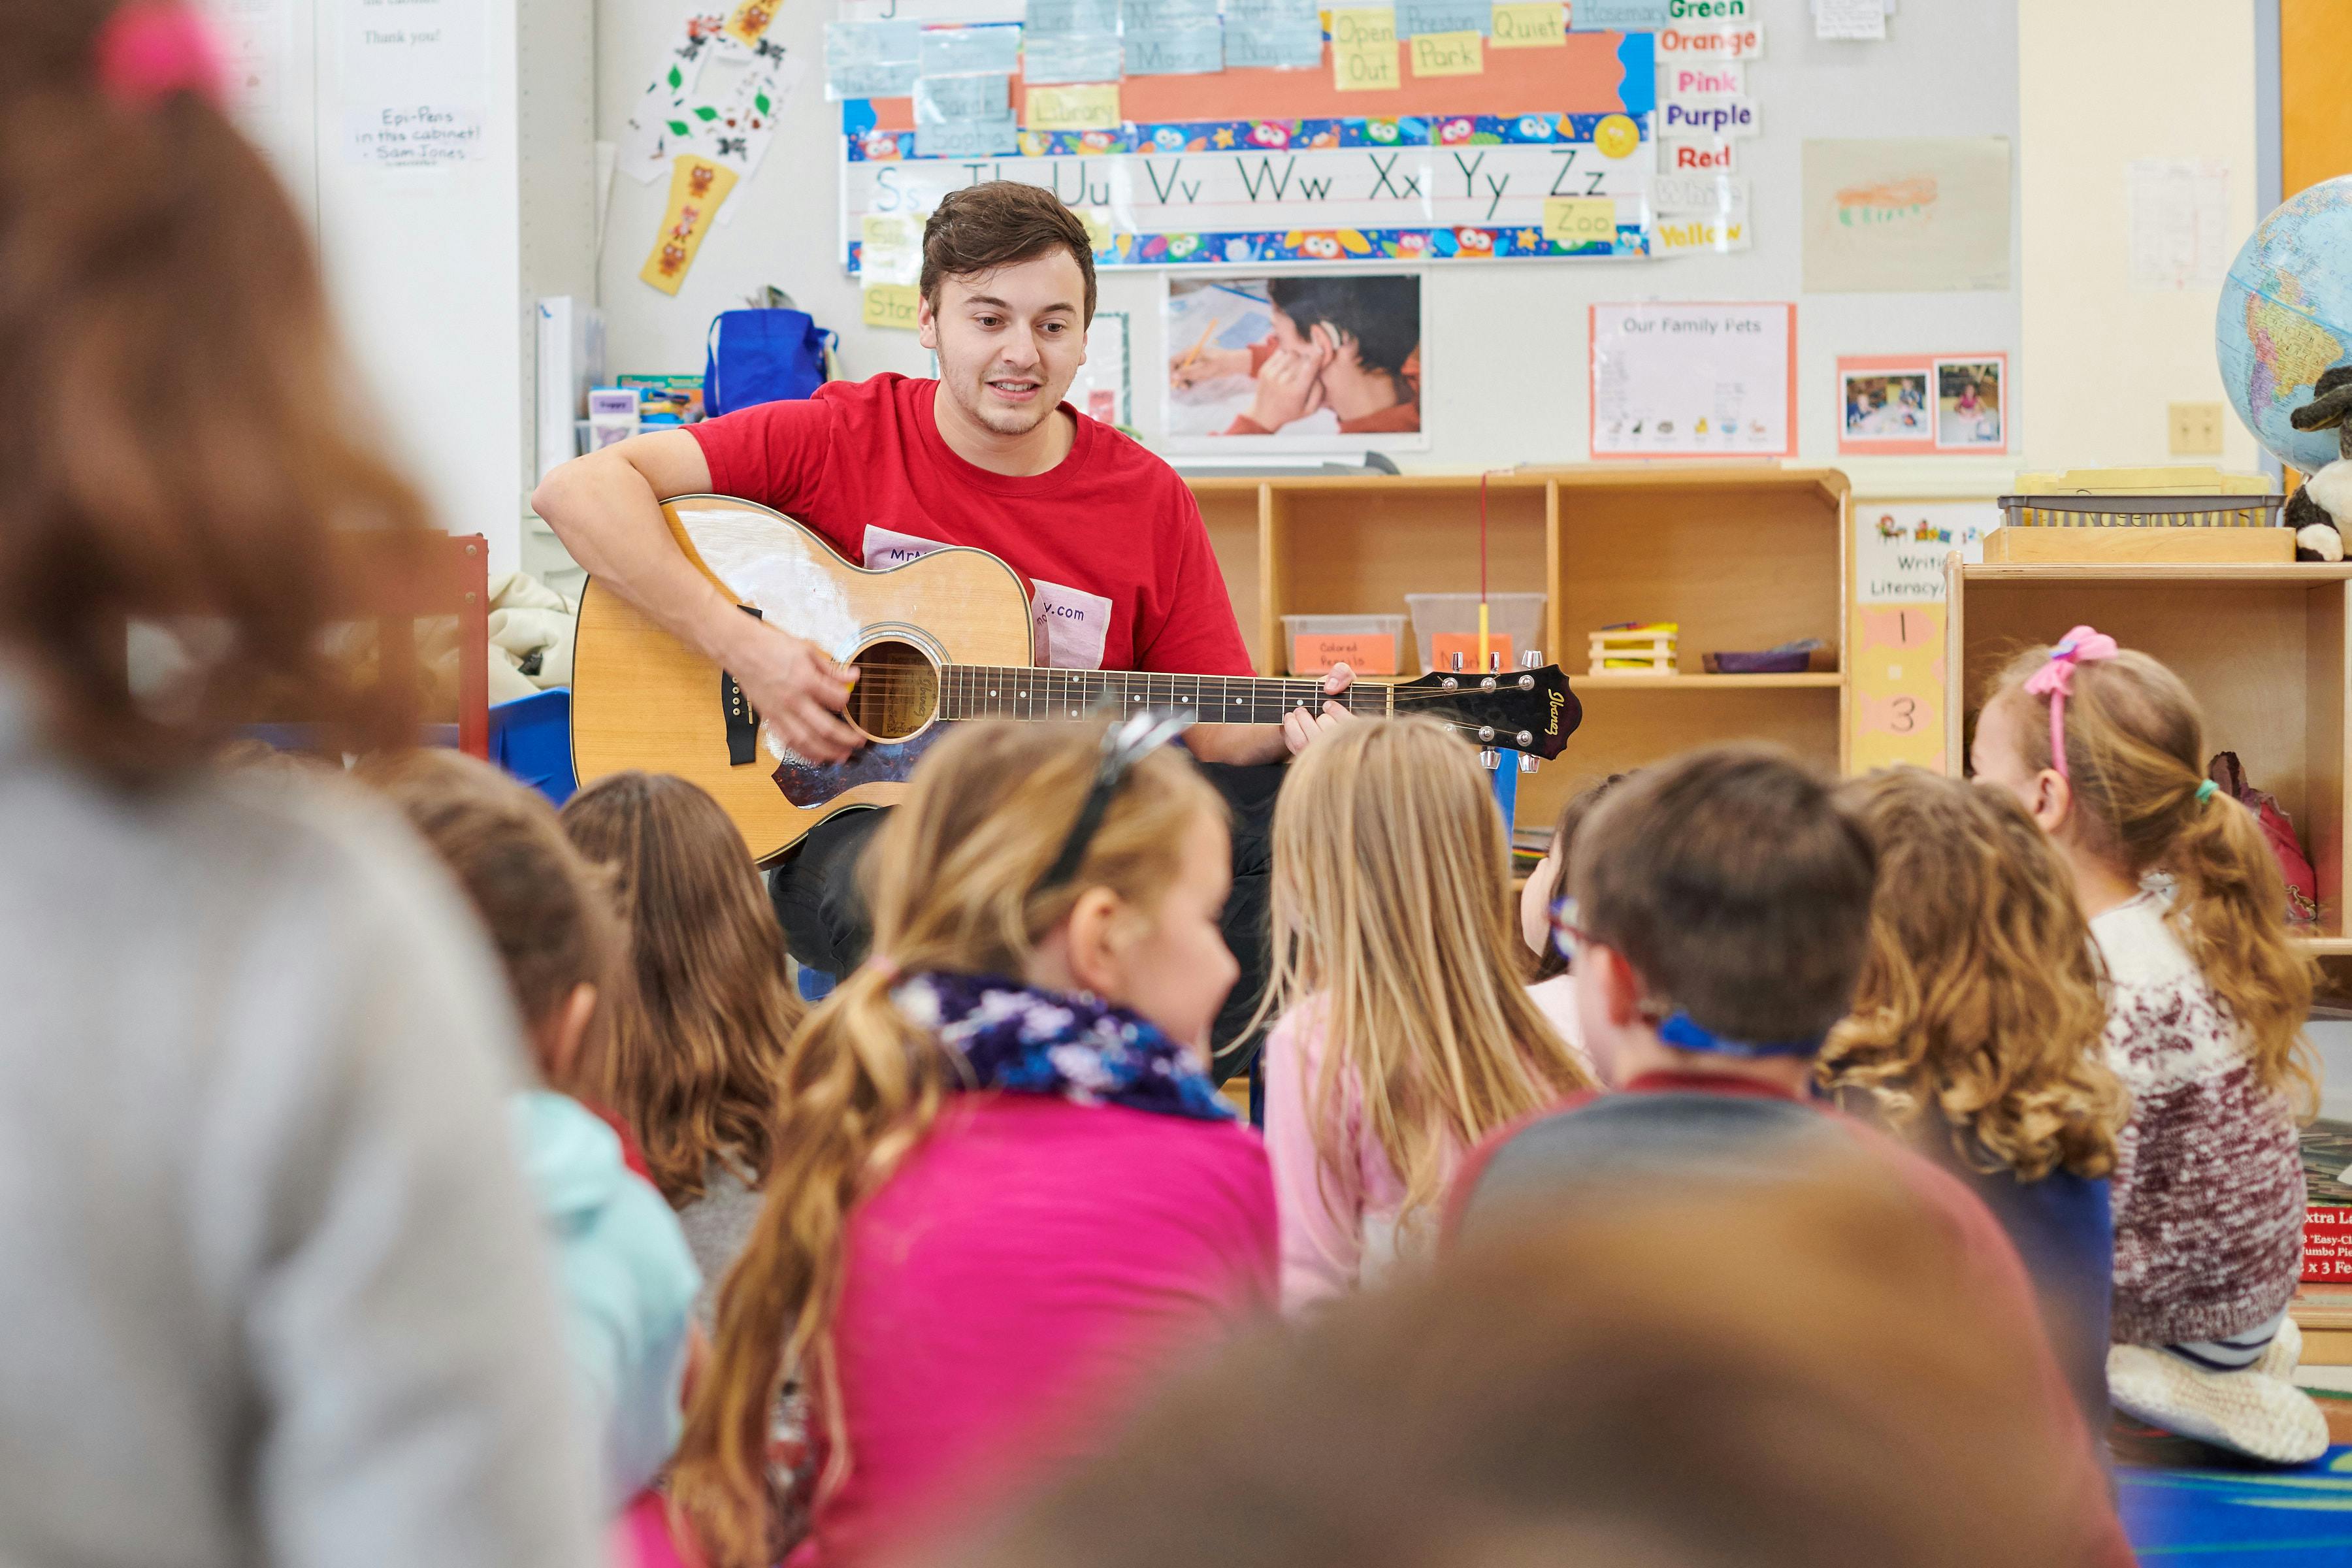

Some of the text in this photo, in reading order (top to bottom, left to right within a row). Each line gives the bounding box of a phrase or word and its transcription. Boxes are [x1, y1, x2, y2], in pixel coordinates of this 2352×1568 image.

[1669, 0, 1744, 18] Green
[365, 30, 404, 44] Thank
[1336, 15, 1394, 50] Open
[1495, 10, 1558, 39] Quiet
[1417, 39, 1475, 67] Park
[1661, 29, 1757, 56] Orange
[1350, 54, 1389, 81] Out
[1678, 71, 1737, 93] Pink
[382, 105, 454, 126] Epi-Pens
[1667, 104, 1752, 131] Purple
[355, 133, 374, 143] in
[377, 131, 406, 142] this
[1677, 146, 1731, 168] Red
[876, 167, 920, 212] Ss
[1053, 160, 1109, 206] Uu
[1145, 158, 1201, 205] Vv
[1236, 155, 1332, 203] Ww
[1369, 152, 1422, 200] Xx
[1454, 150, 1510, 221] Yy
[1549, 149, 1607, 197] Zz
[1557, 204, 1610, 233] Zoo
[868, 289, 917, 319] Stor
[1624, 317, 1762, 336] Our Family Pets
[1900, 611, 1906, 644] 1
[1320, 642, 1358, 652] Colored
[1544, 688, 1565, 736] Ibanez
[1891, 697, 1915, 732] 3
[2304, 1213, 2336, 1224] xtra
[2321, 1262, 2330, 1274] 3
